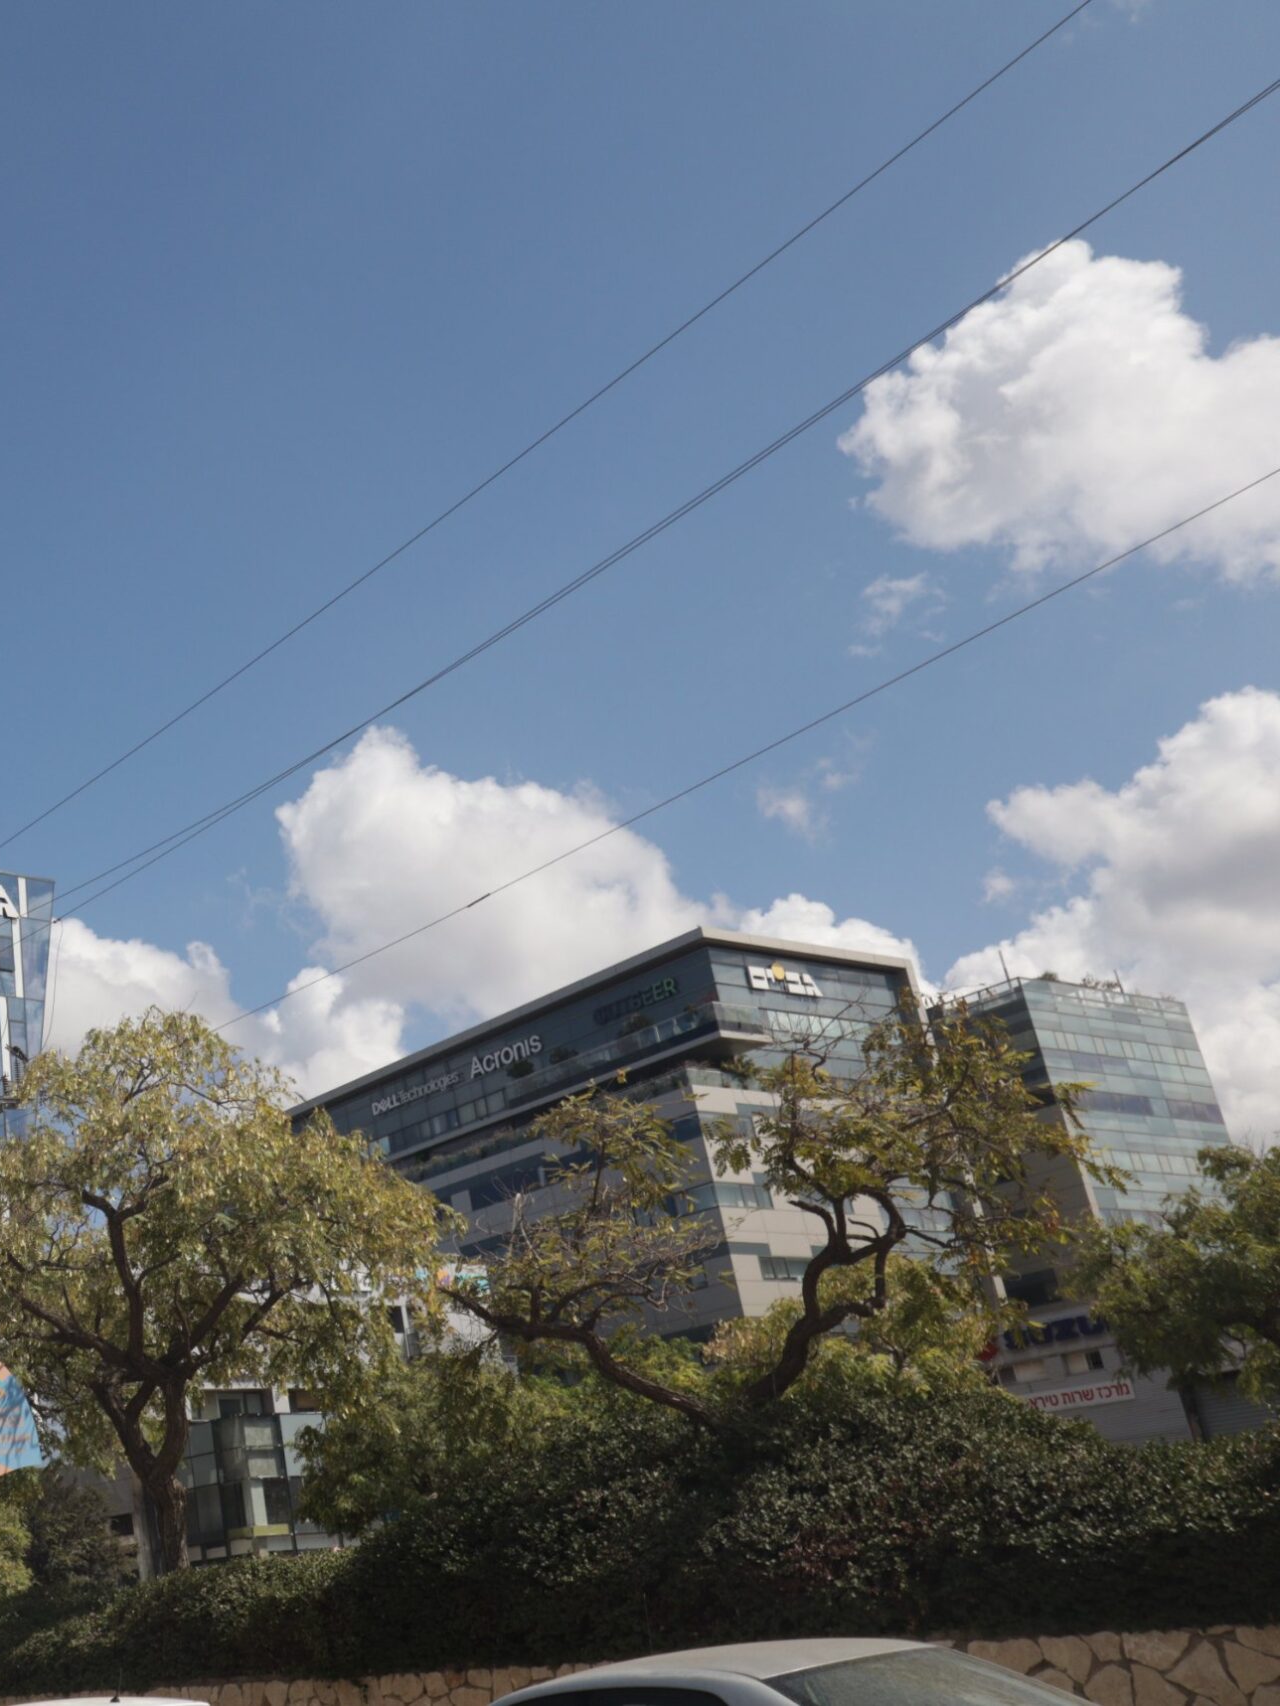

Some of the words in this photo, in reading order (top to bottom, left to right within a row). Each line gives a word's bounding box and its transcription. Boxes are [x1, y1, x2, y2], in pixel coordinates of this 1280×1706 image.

[470, 1034, 542, 1079] Acronis
[399, 1071, 459, 1102] Technologies
[1061, 1388, 1094, 1404] שרות
[1095, 1383, 1131, 1399] מרכז
